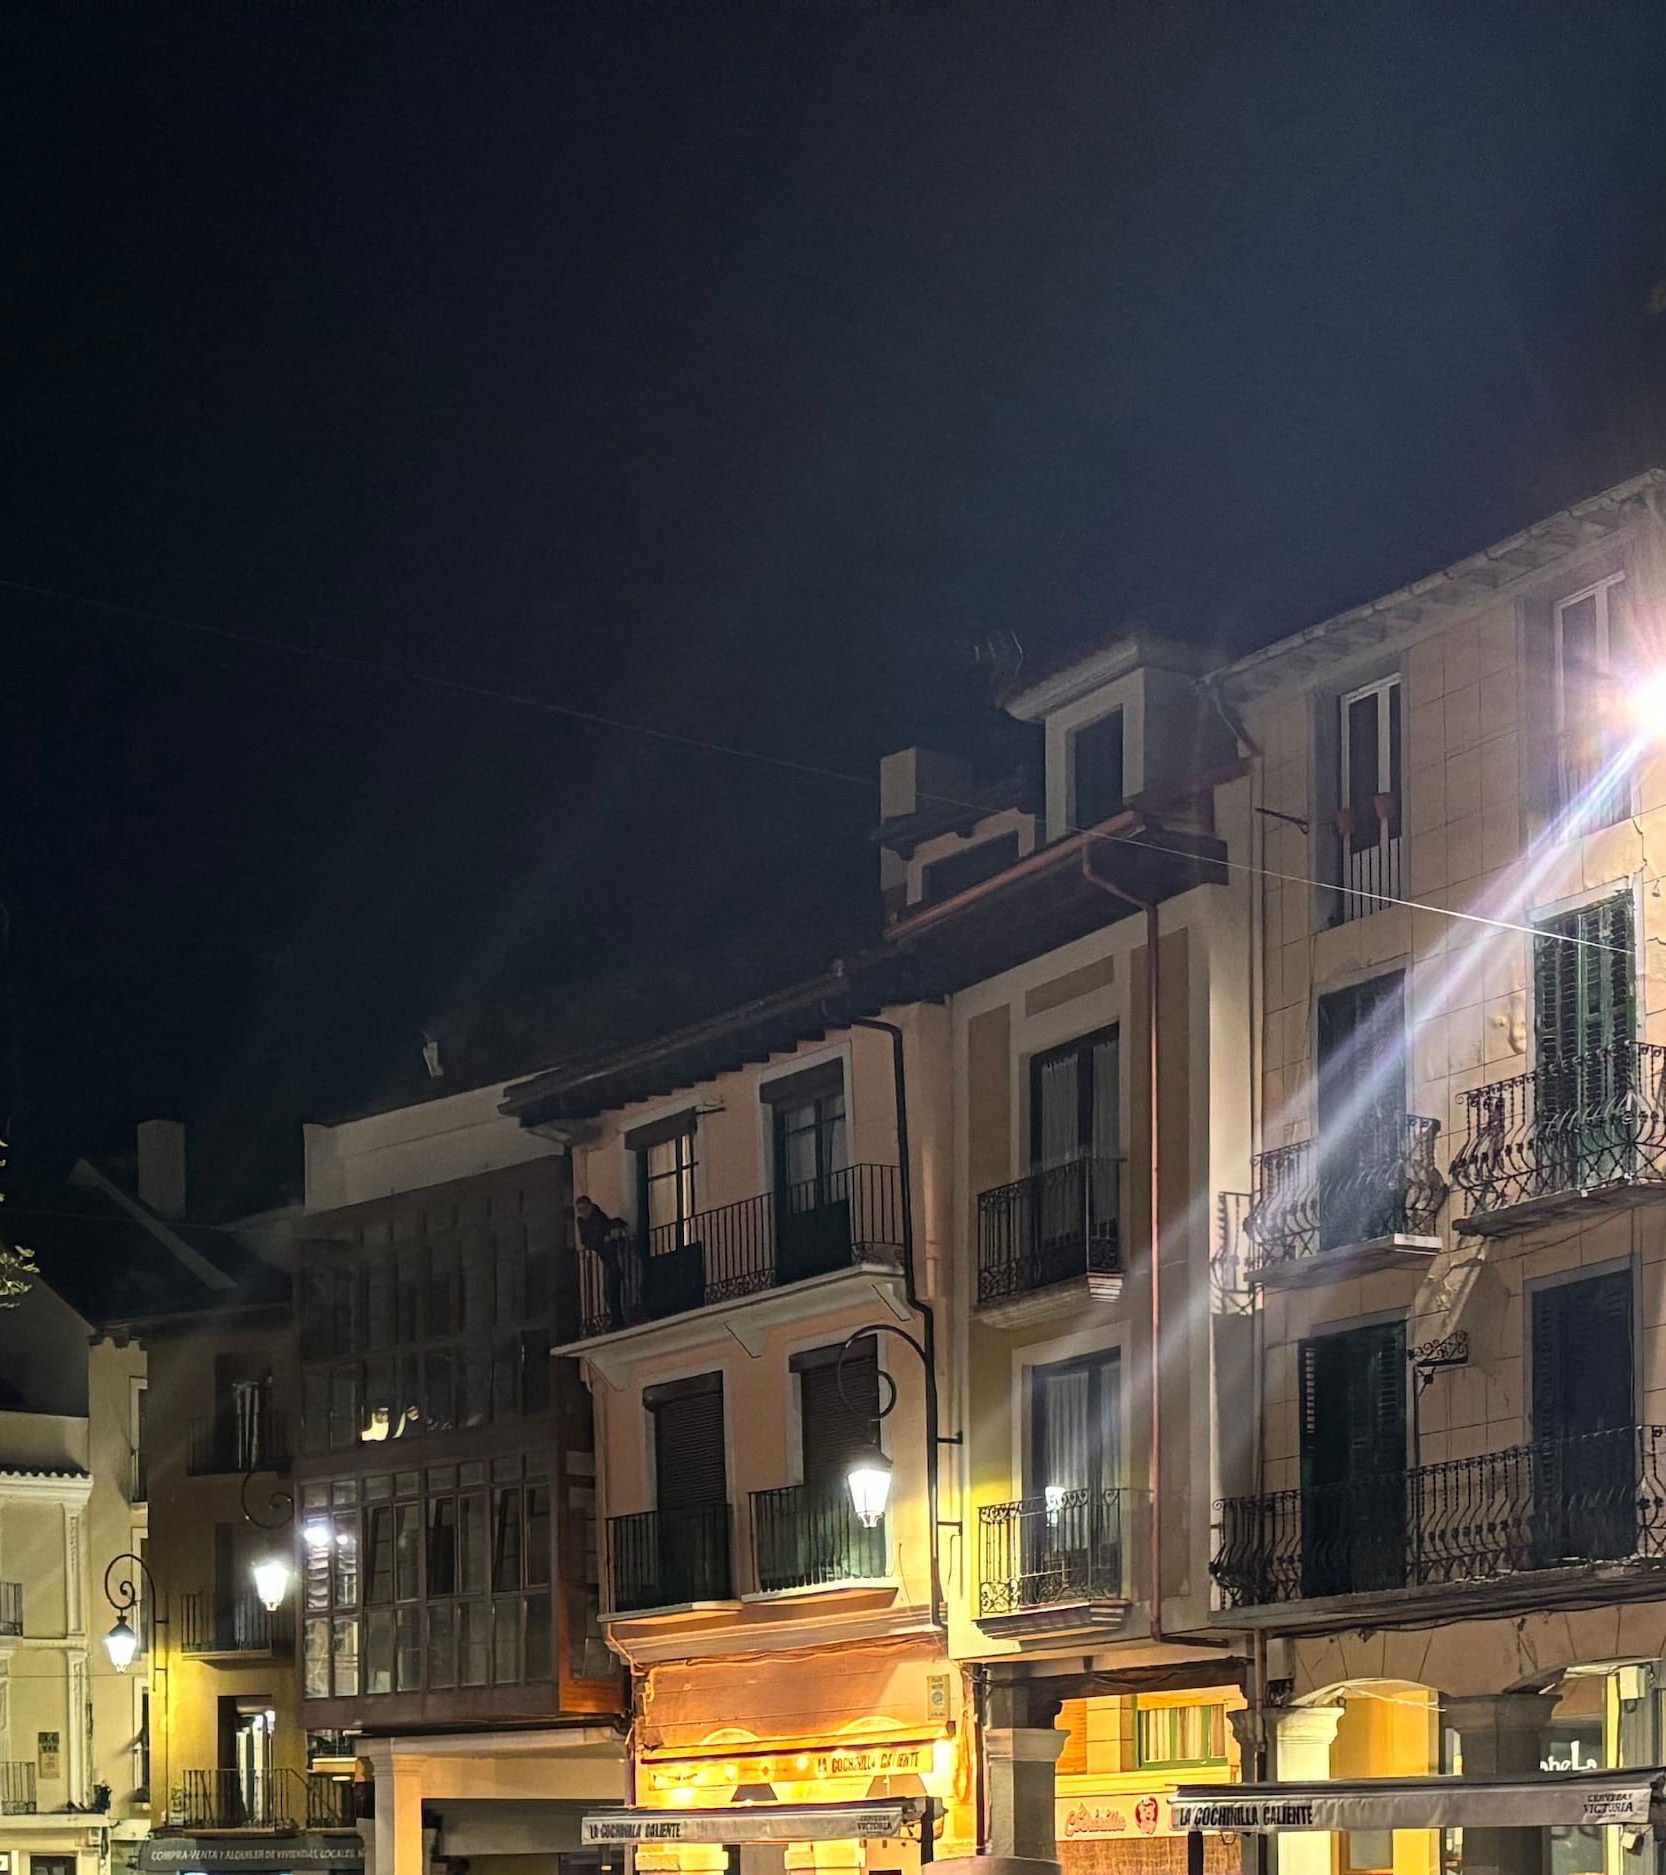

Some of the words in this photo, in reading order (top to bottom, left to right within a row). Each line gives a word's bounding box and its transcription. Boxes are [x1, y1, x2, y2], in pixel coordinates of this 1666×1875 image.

[1179, 1806, 1192, 1826] LA
[1194, 1806, 1259, 1826] COCHINILLA
[1263, 1805, 1313, 1826] CALIENTE
[1583, 1802, 1634, 1815] VICTORIA
[589, 1823, 599, 1840] LA
